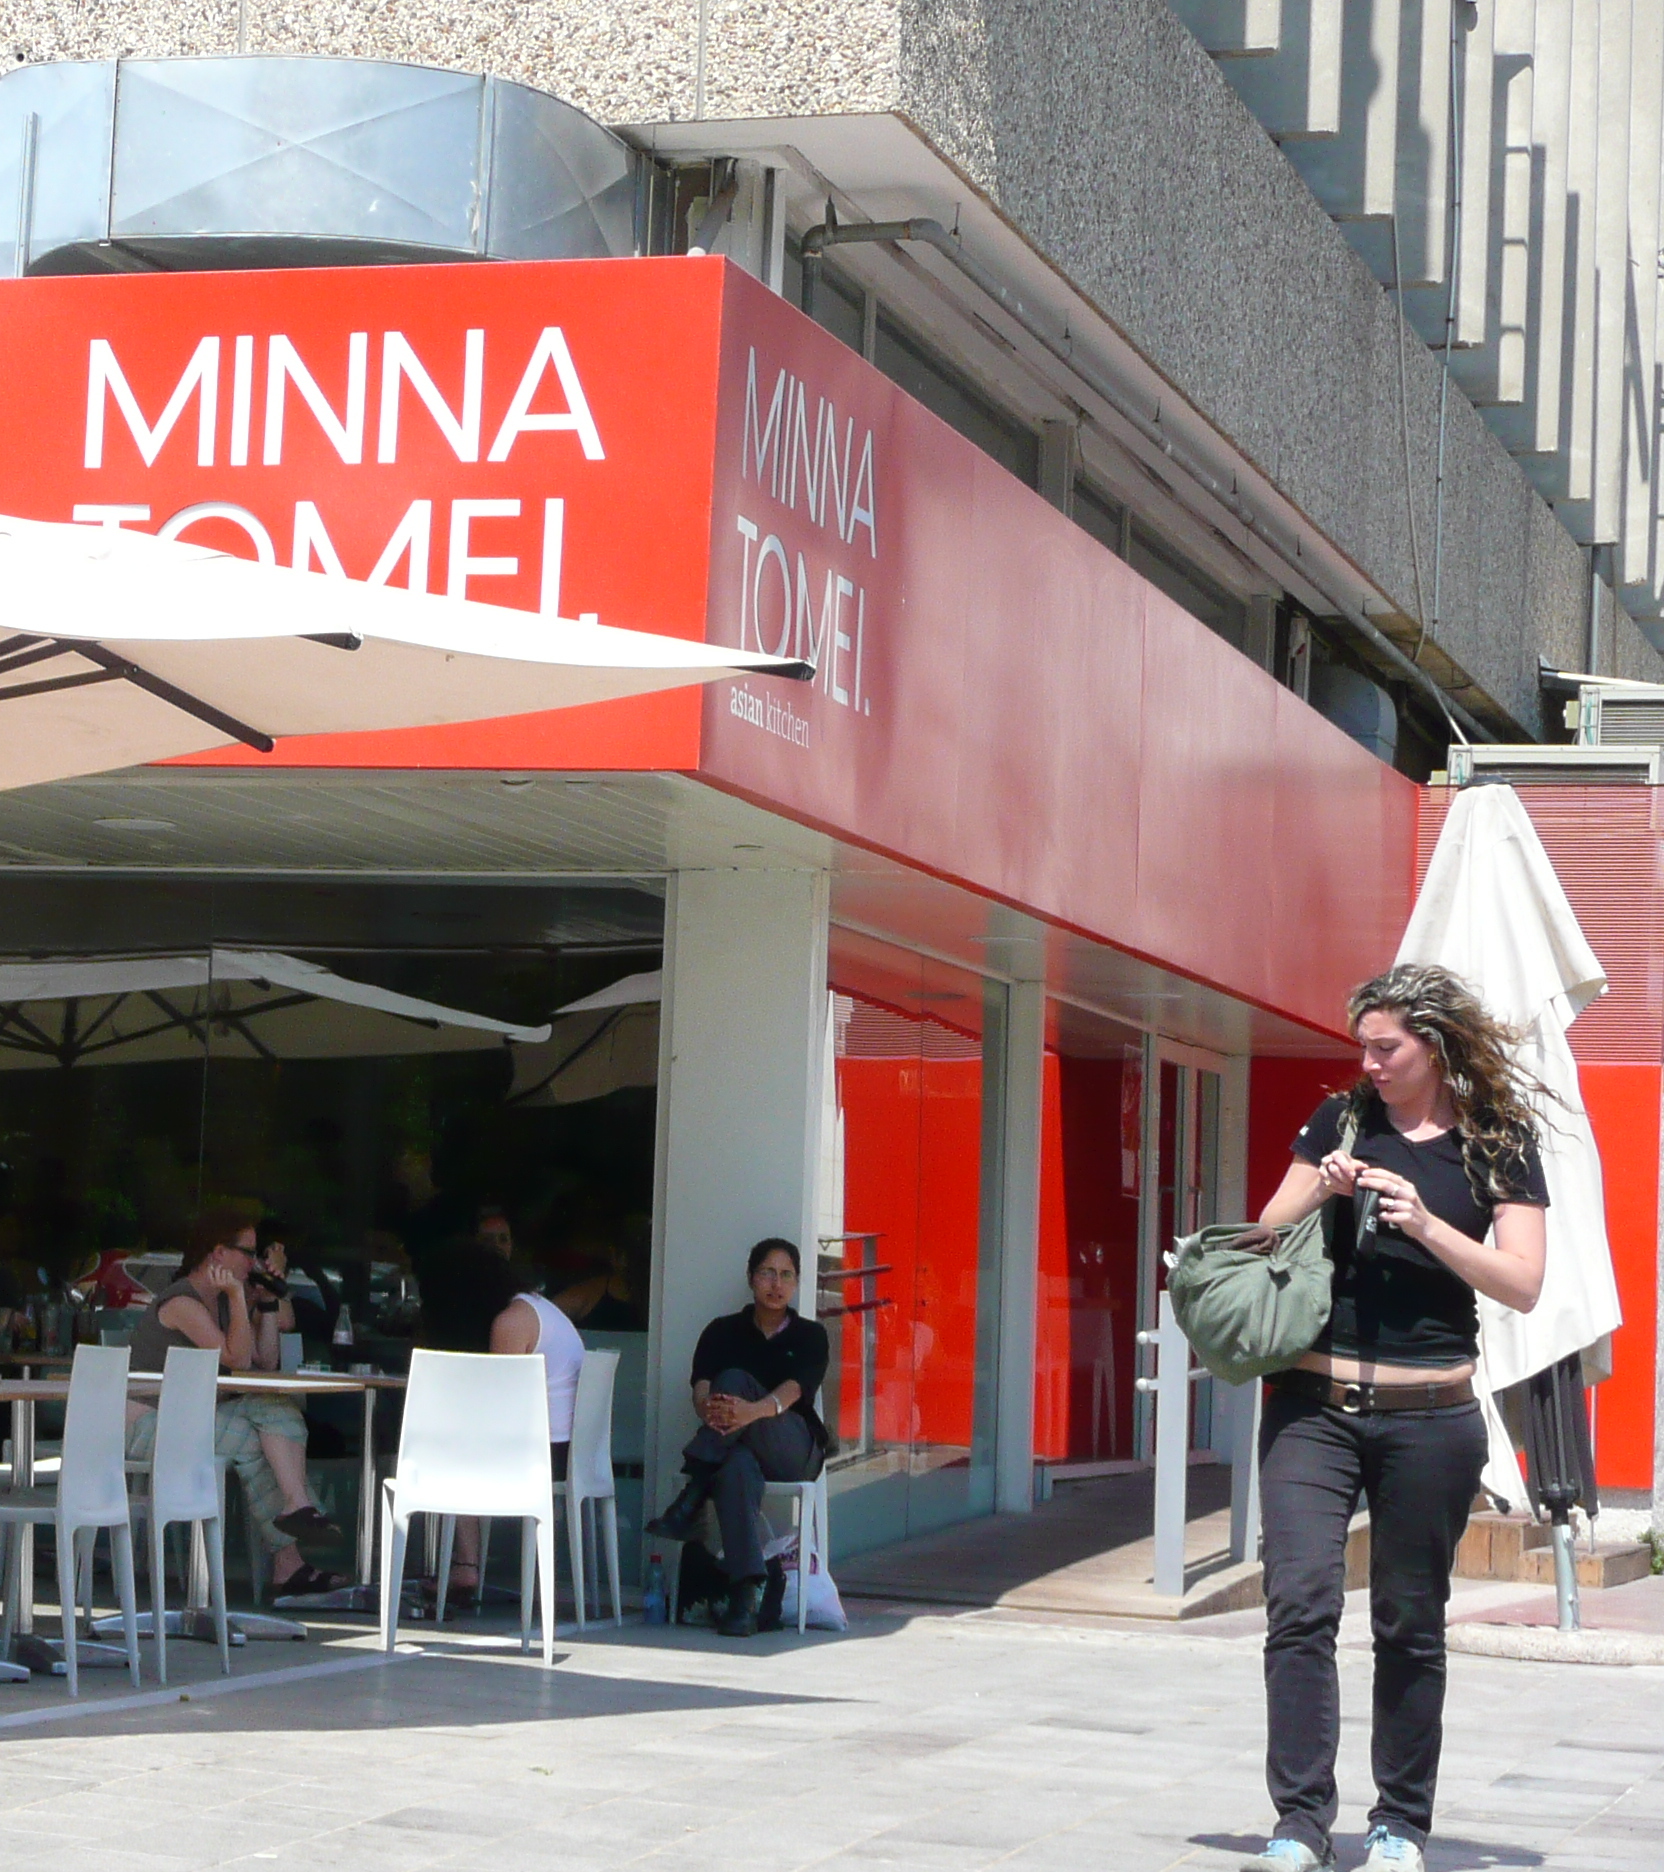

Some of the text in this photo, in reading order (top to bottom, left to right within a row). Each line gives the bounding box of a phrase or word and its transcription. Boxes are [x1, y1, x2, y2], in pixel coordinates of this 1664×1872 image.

[83, 326, 606, 469] MINNA
[742, 345, 877, 558] MINNA
[72, 498, 598, 626] MEI.
[730, 682, 810, 749] asian kitchen
